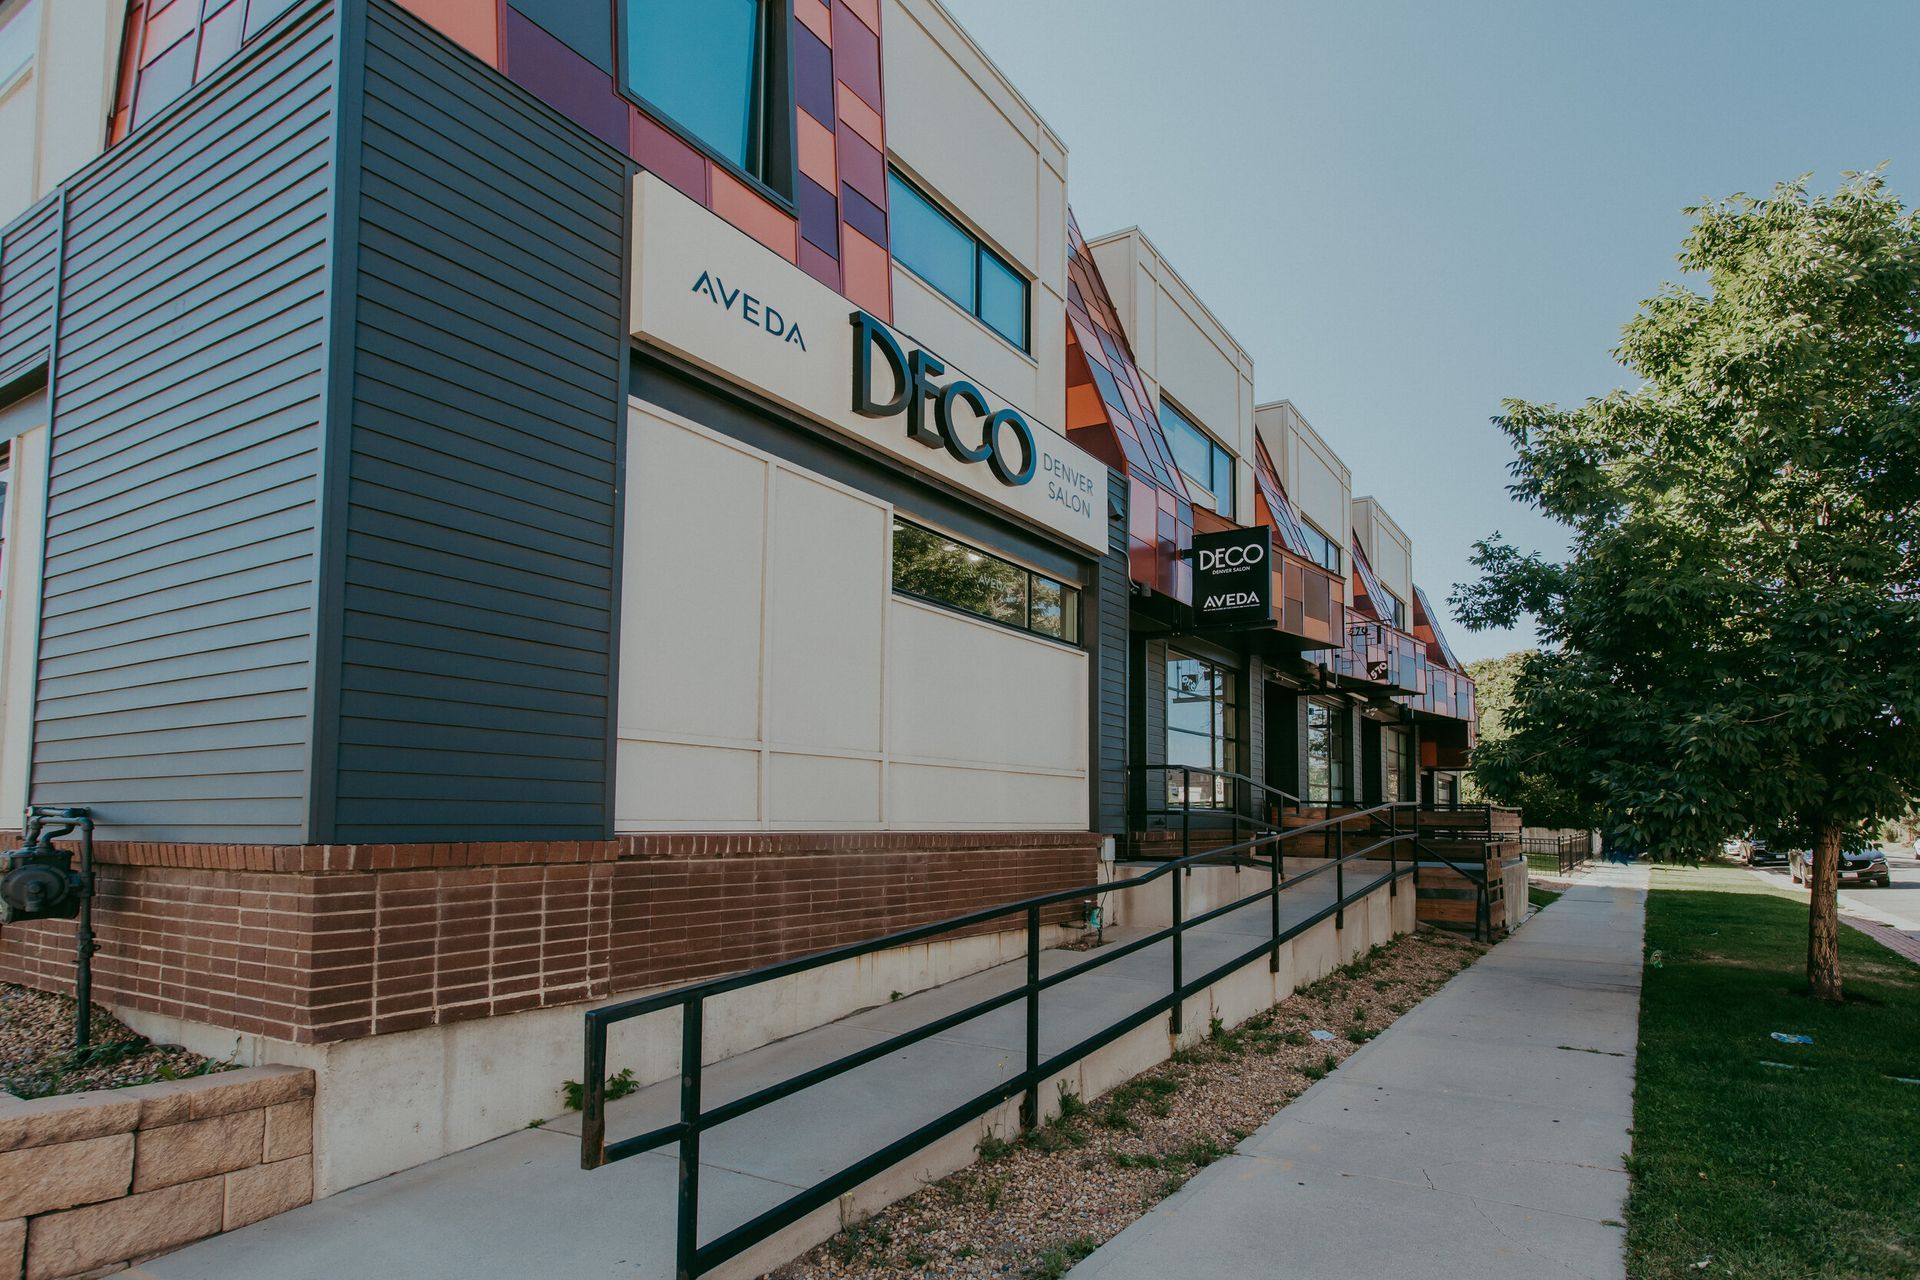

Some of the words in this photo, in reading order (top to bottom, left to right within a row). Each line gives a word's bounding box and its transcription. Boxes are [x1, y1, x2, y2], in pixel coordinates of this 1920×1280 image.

[691, 270, 807, 353] AVEDA
[849, 310, 1037, 487] DECO
[1043, 452, 1093, 496] DENVER
[1048, 481, 1090, 518] SALON
[1199, 543, 1264, 571] DECO
[1203, 591, 1260, 608] AVEDA
[1370, 662, 1387, 680] 570
